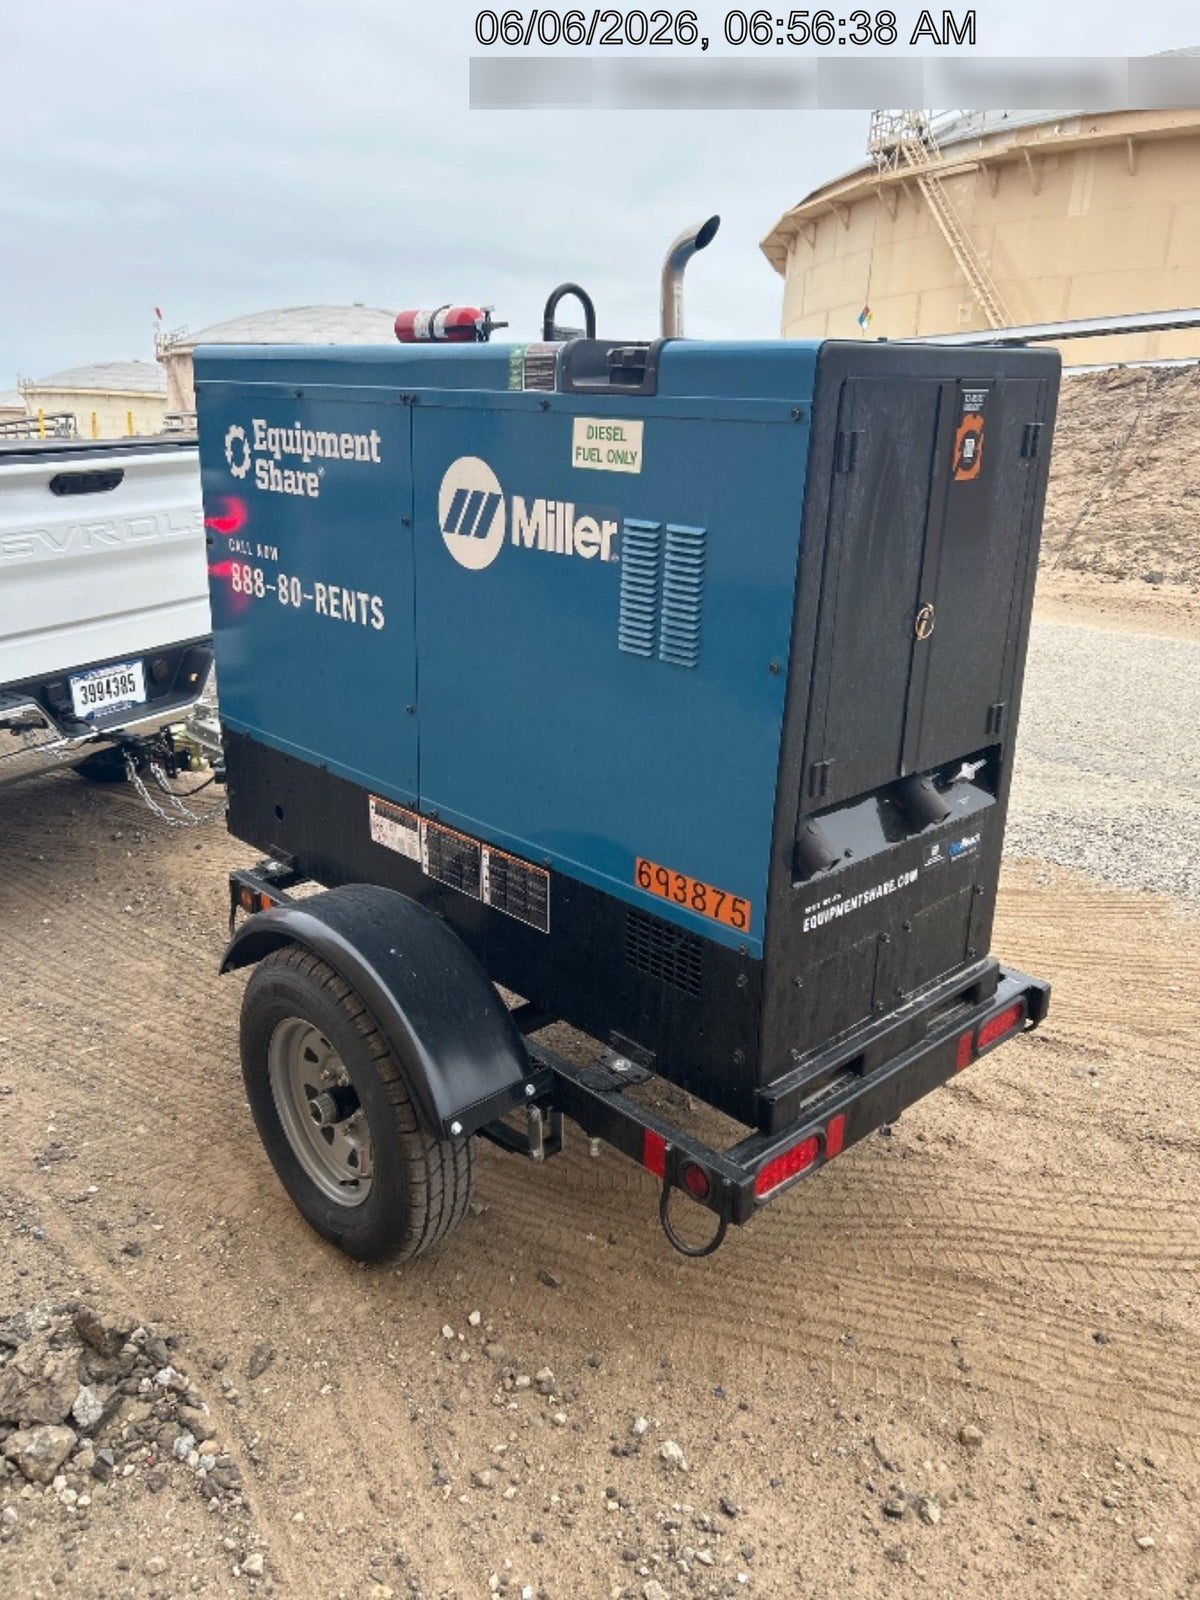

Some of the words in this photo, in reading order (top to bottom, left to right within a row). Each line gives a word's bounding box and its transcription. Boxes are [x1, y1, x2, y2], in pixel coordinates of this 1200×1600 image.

[252, 418, 382, 463] Equipment
[575, 446, 603, 463] FUEL
[607, 449, 638, 466] ONLY
[586, 424, 627, 442] DIESEL
[511, 495, 618, 562] Miller
[231, 562, 385, 630] 888-80-RENTS
[80, 673, 136, 705] 3994385
[637, 861, 746, 929] 693875
[803, 868, 918, 932] EQUIPMENTSHARE.COM
